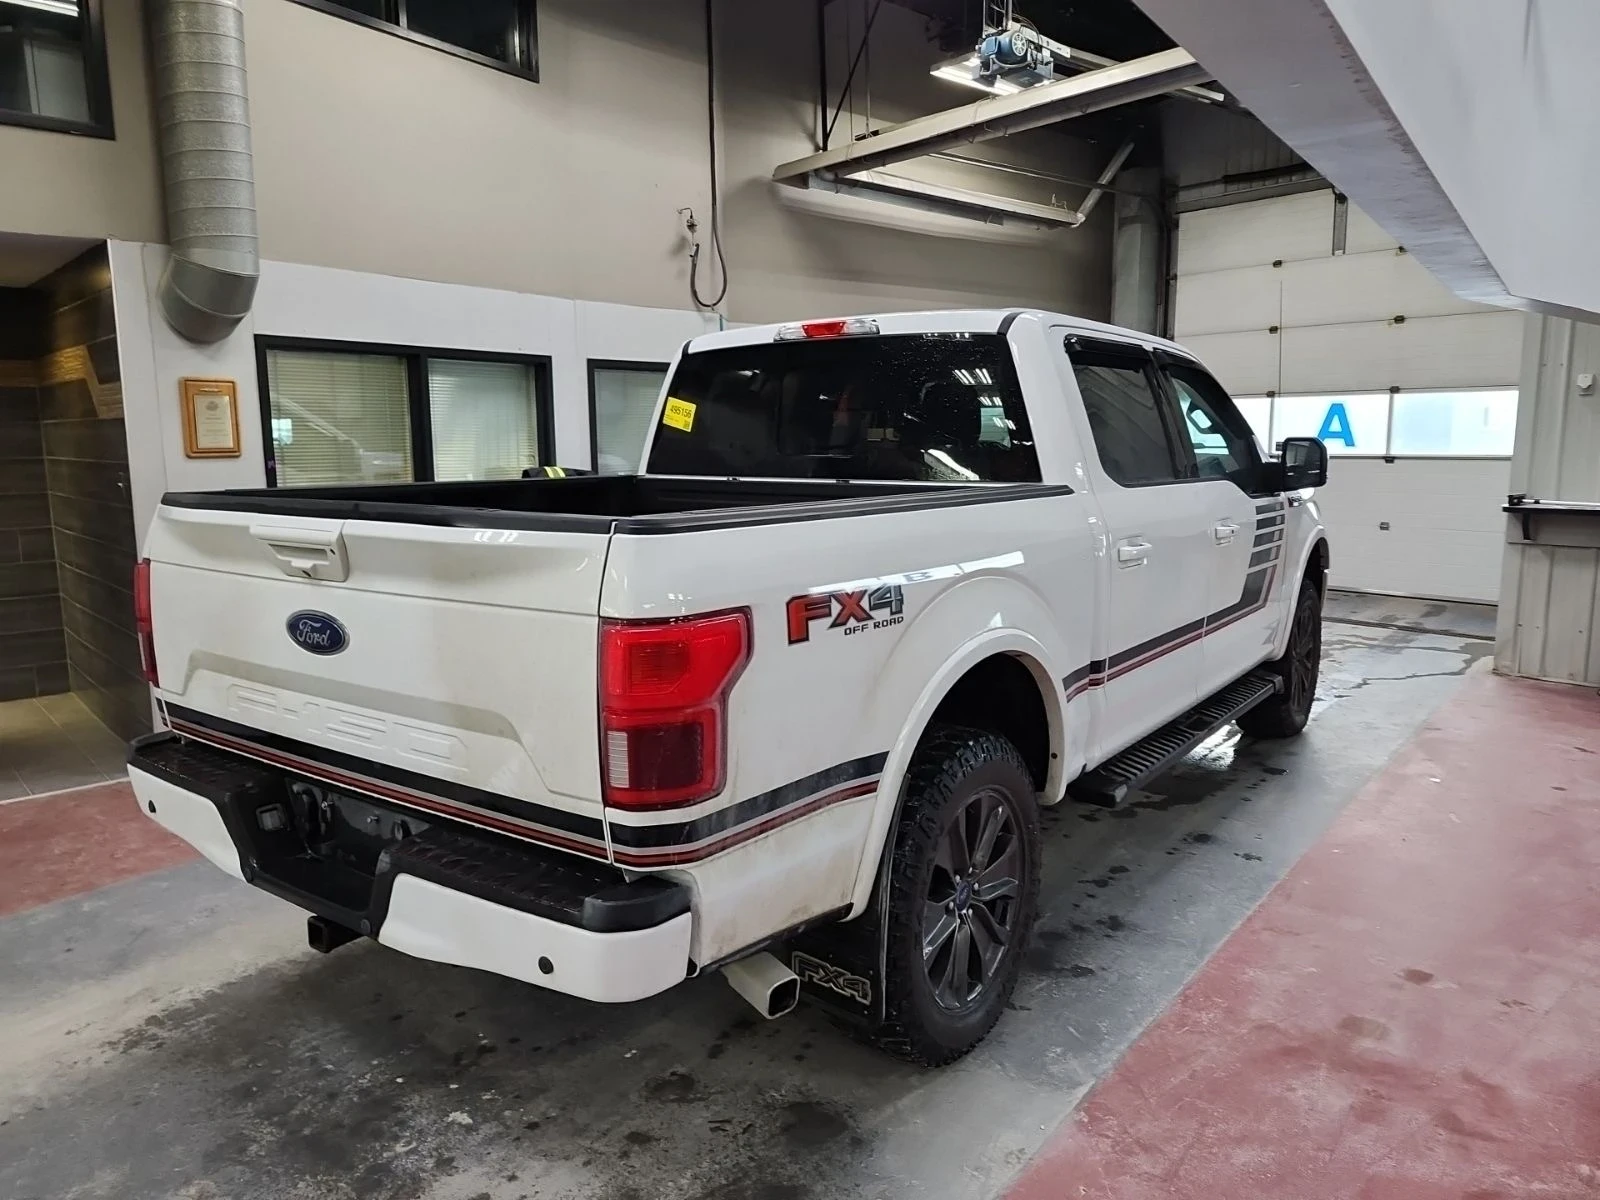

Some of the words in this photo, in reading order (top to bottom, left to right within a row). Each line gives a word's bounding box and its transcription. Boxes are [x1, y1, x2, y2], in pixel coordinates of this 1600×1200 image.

[1317, 403, 1355, 447] A
[296, 619, 331, 646] Ford
[786, 583, 904, 645] FX4
[844, 624, 869, 636] OFF
[873, 616, 904, 630] ROAD
[792, 951, 871, 1005] FX4
